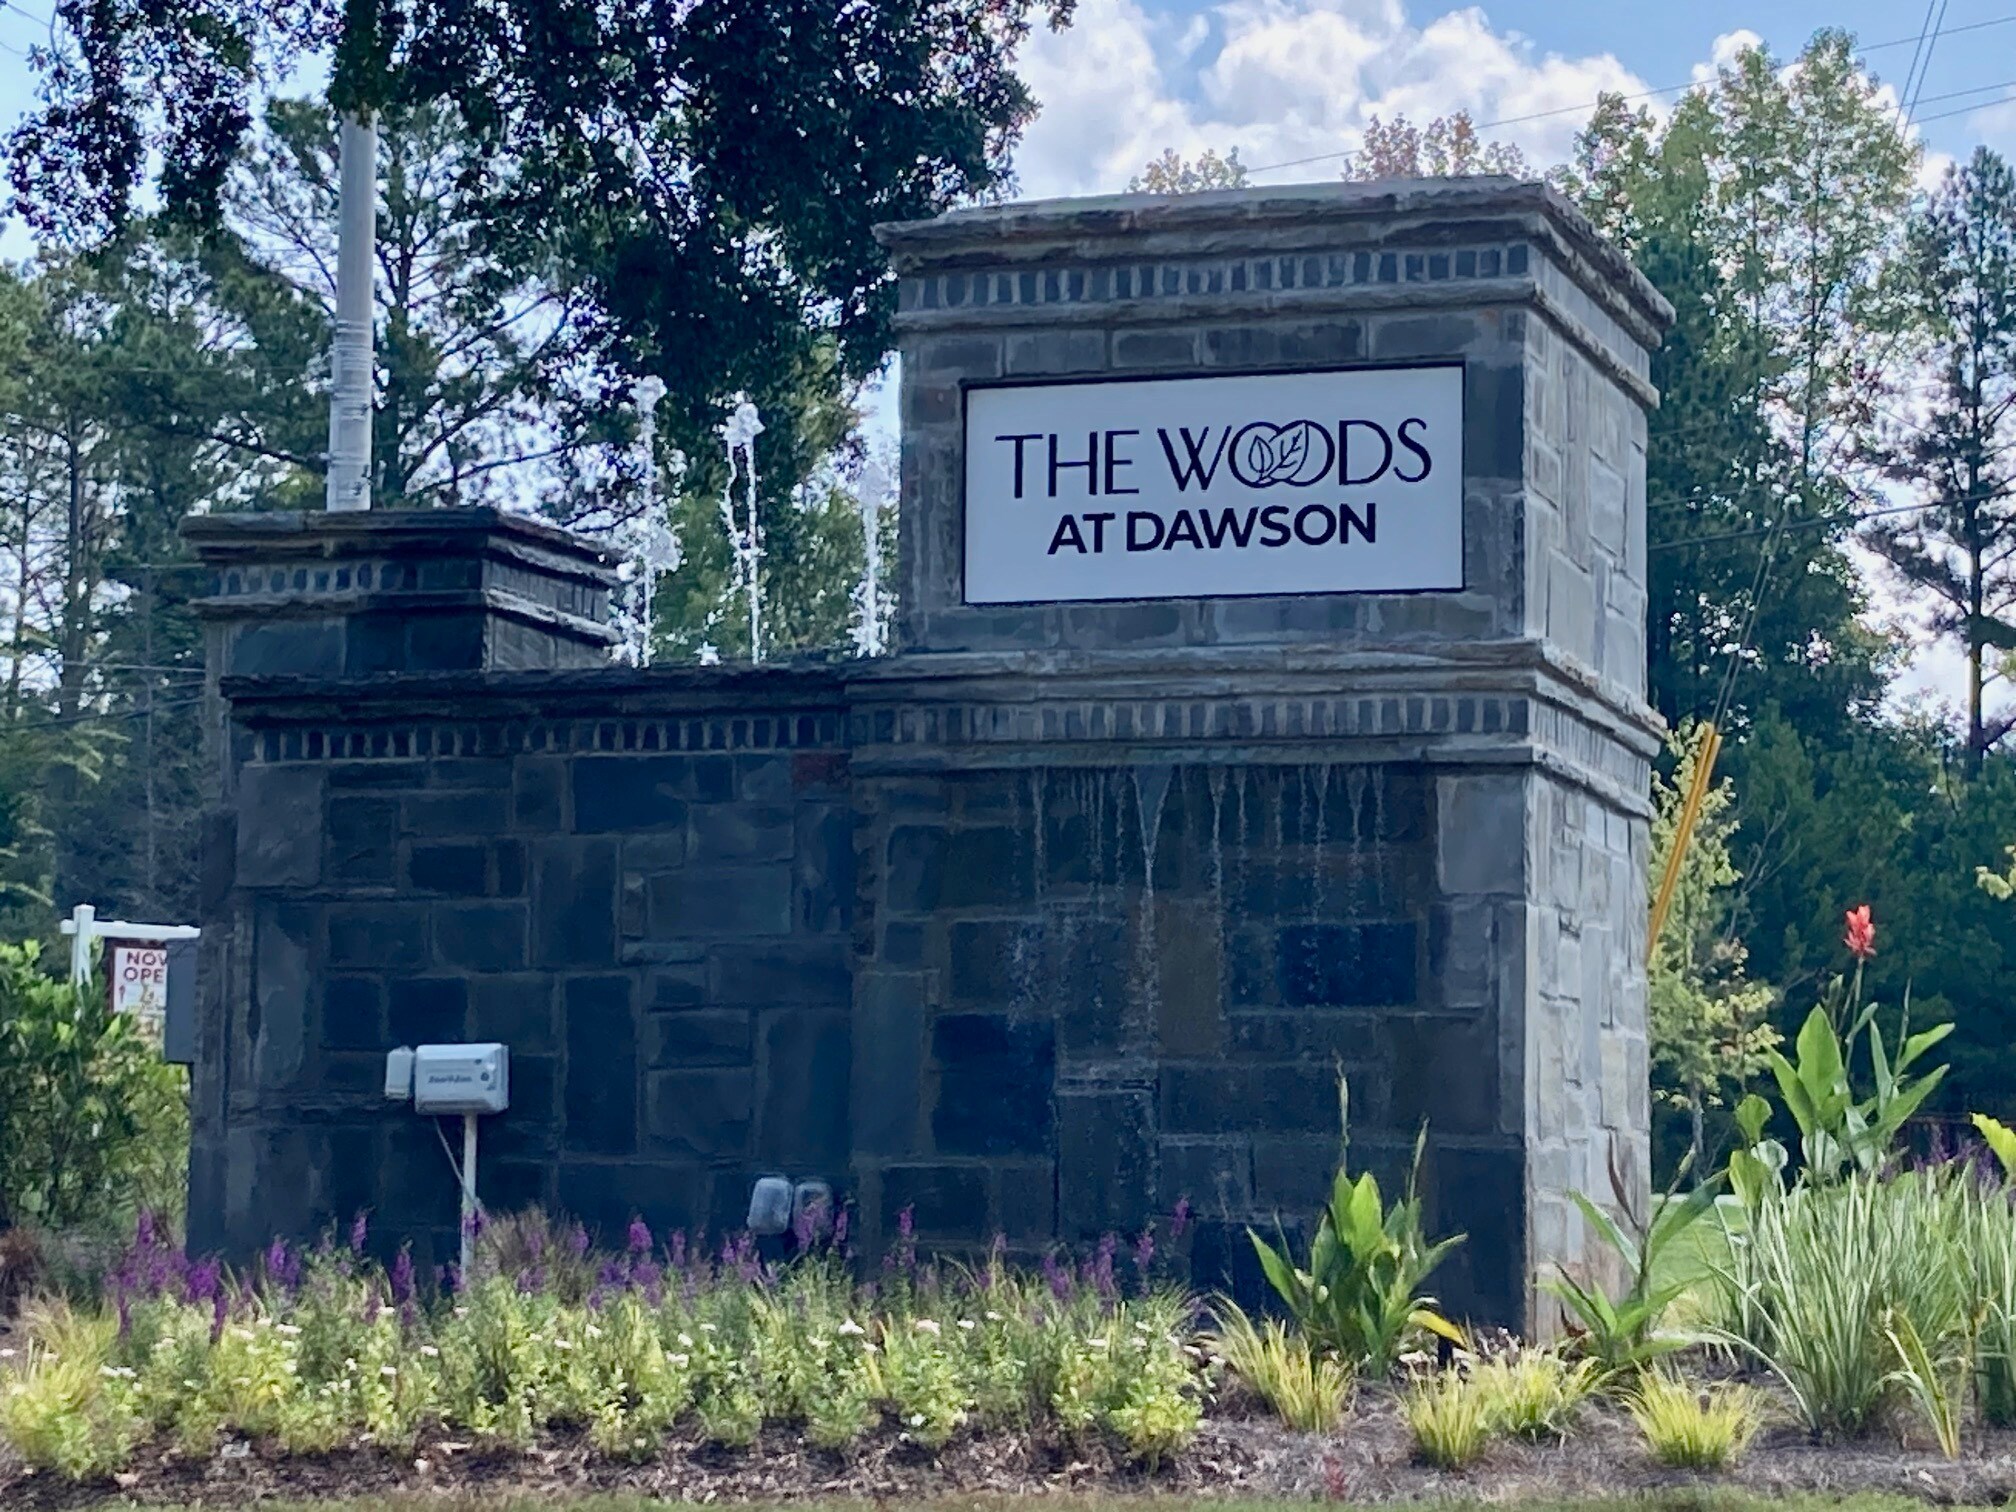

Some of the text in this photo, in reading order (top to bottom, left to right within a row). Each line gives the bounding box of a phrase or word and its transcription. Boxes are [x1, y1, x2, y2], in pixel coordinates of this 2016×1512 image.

[995, 418, 1432, 499] THE WOODS
[1047, 503, 1376, 555] AT DAWSON
